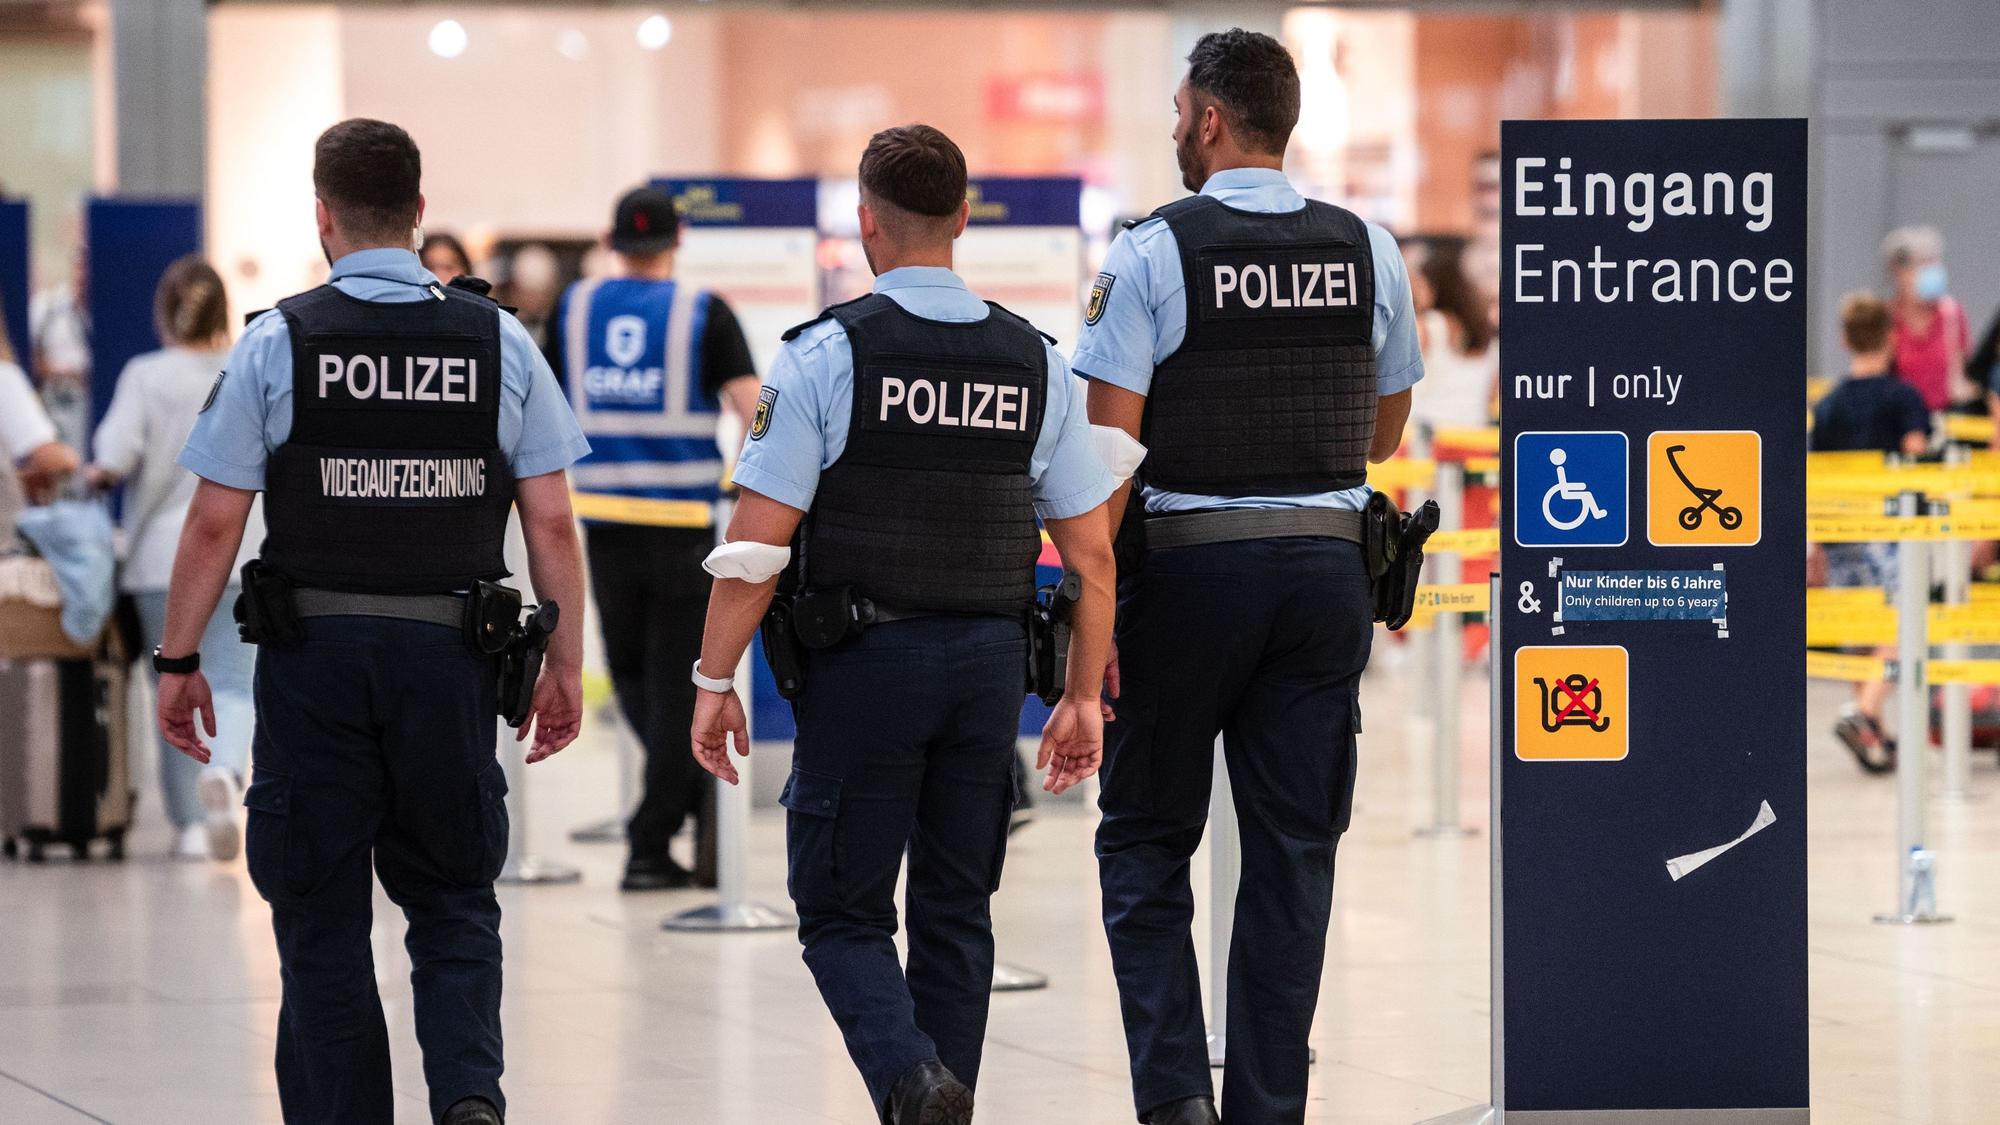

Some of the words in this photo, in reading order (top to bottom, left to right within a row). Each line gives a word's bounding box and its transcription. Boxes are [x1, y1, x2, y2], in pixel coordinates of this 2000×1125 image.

[1515, 157, 1773, 232] Eingang
[1213, 262, 1357, 309] POLIZEI
[1515, 244, 1793, 303] Entrance
[318, 354, 477, 403] POLIZEI
[1515, 376, 1573, 399] nur
[1613, 367, 1683, 406] only
[879, 376, 1029, 431] POLIZEI
[320, 457, 485, 498] VIDEOAUFZEICHNUNG
[1517, 580, 1541, 614] &
[1565, 595, 1592, 608] Only
[1594, 594, 1641, 607] children
[1644, 597, 1660, 609] up
[1662, 597, 1675, 607] to
[1677, 596, 1685, 607] 6
[1687, 598, 1718, 609] years
[1566, 576, 1593, 589] Nur
[1596, 575, 1643, 589] Kinder
[1647, 575, 1668, 589] bis
[1671, 576, 1680, 590] 6
[1682, 576, 1722, 590] Jahre
